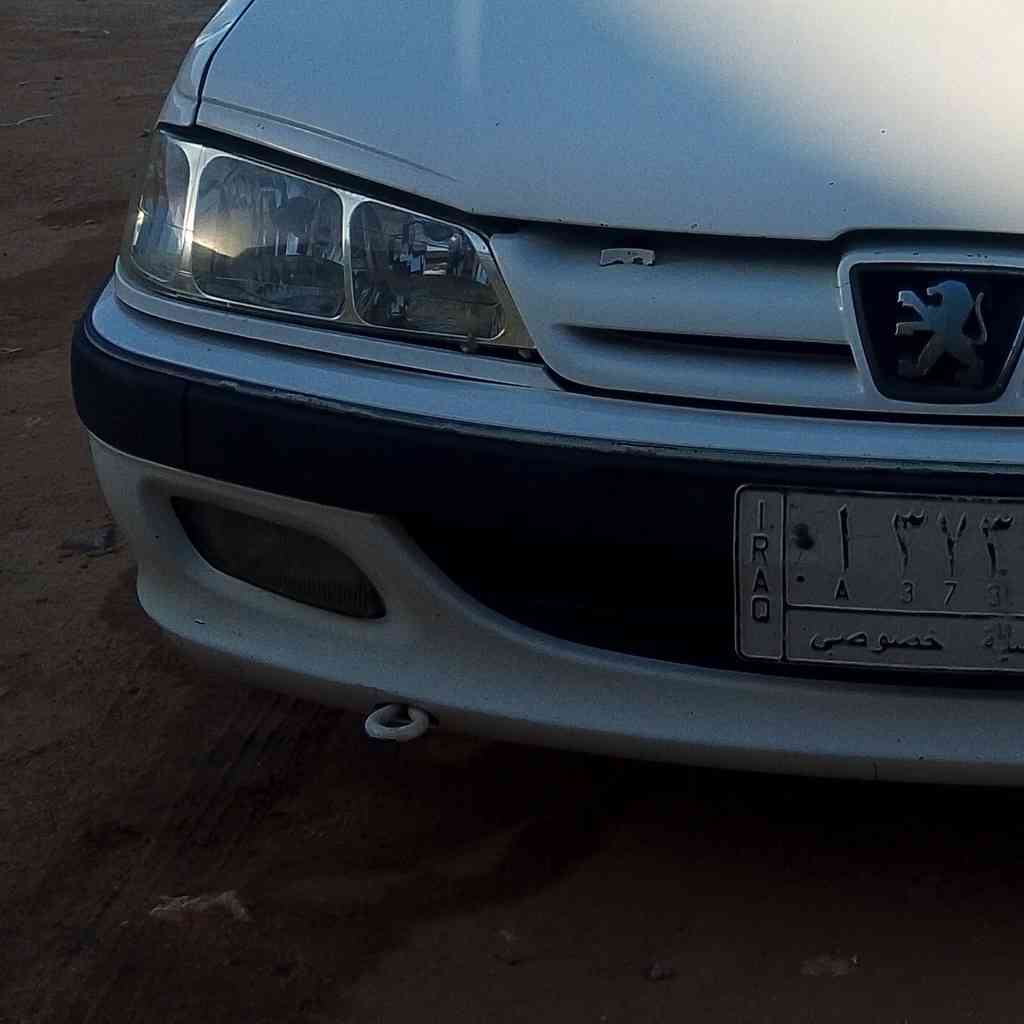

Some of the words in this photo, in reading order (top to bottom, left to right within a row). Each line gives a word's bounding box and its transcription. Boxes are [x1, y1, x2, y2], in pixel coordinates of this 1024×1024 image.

[751, 498, 770, 624] IRAQ
[833, 578, 849, 601] A
[808, 628, 945, 657] خصوصي
